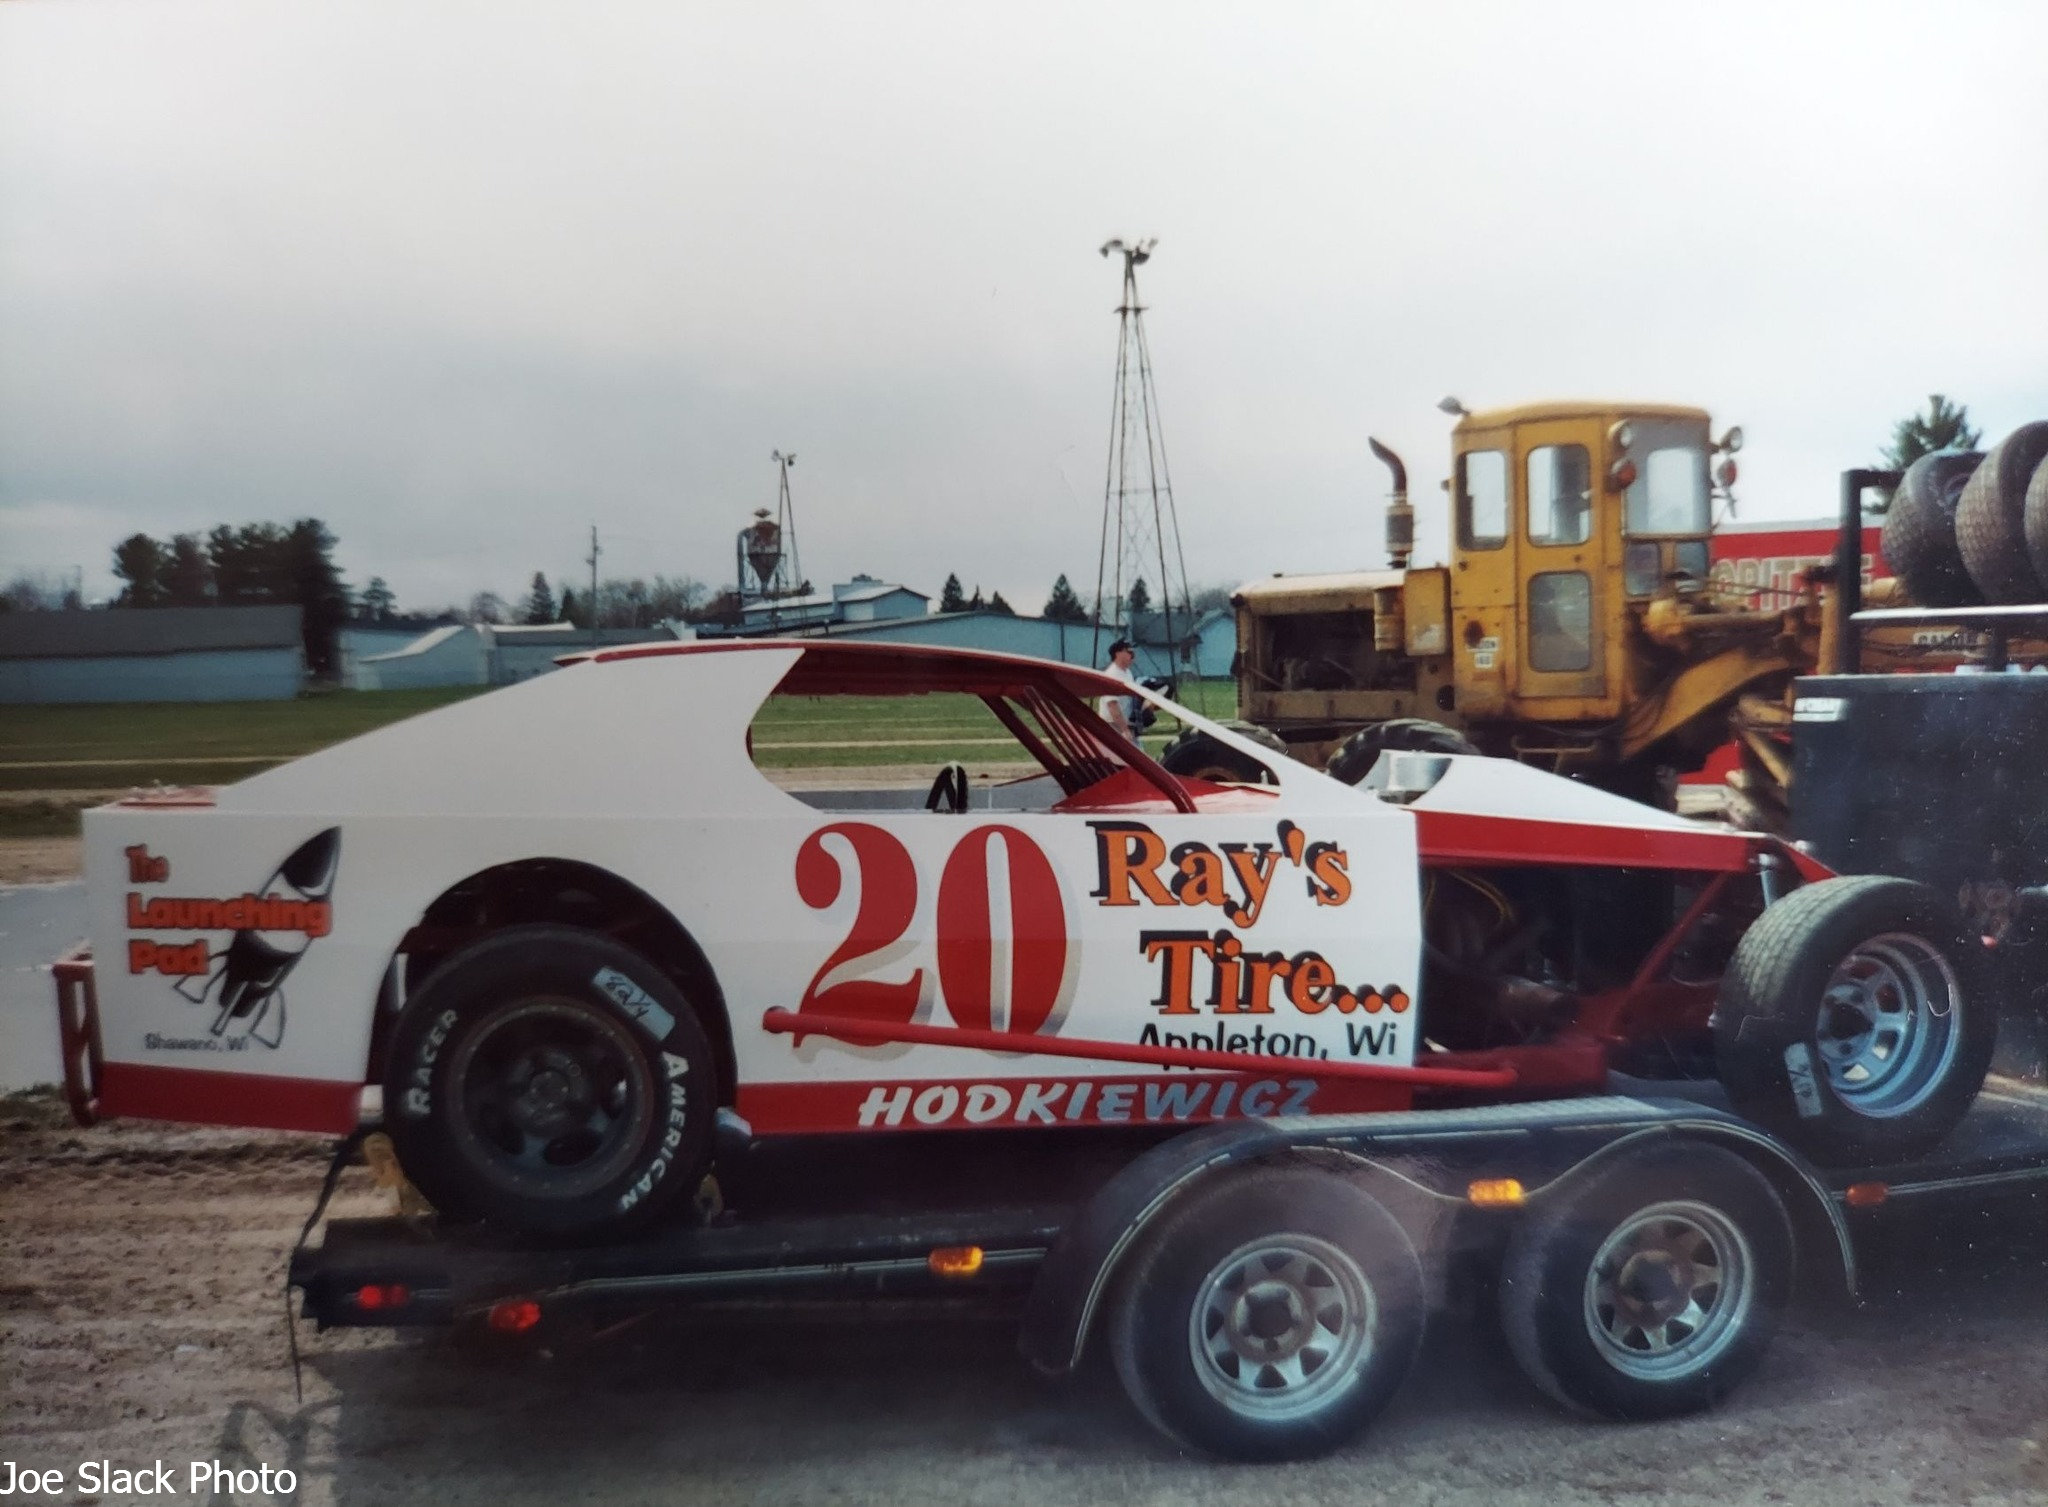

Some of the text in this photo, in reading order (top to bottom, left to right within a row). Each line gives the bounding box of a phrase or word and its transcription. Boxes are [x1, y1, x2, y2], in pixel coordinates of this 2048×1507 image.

[126, 892, 333, 937] Launching
[1086, 819, 1352, 928] Ray's
[128, 938, 210, 975] Pad
[794, 822, 1074, 1055] 20
[1139, 929, 1410, 1015] Tire...
[406, 1009, 458, 1115] RACER
[1346, 1022, 1397, 1056] Wi
[618, 1051, 690, 1211] AMERICAN
[858, 1081, 1318, 1127] HODKIEWICZ
